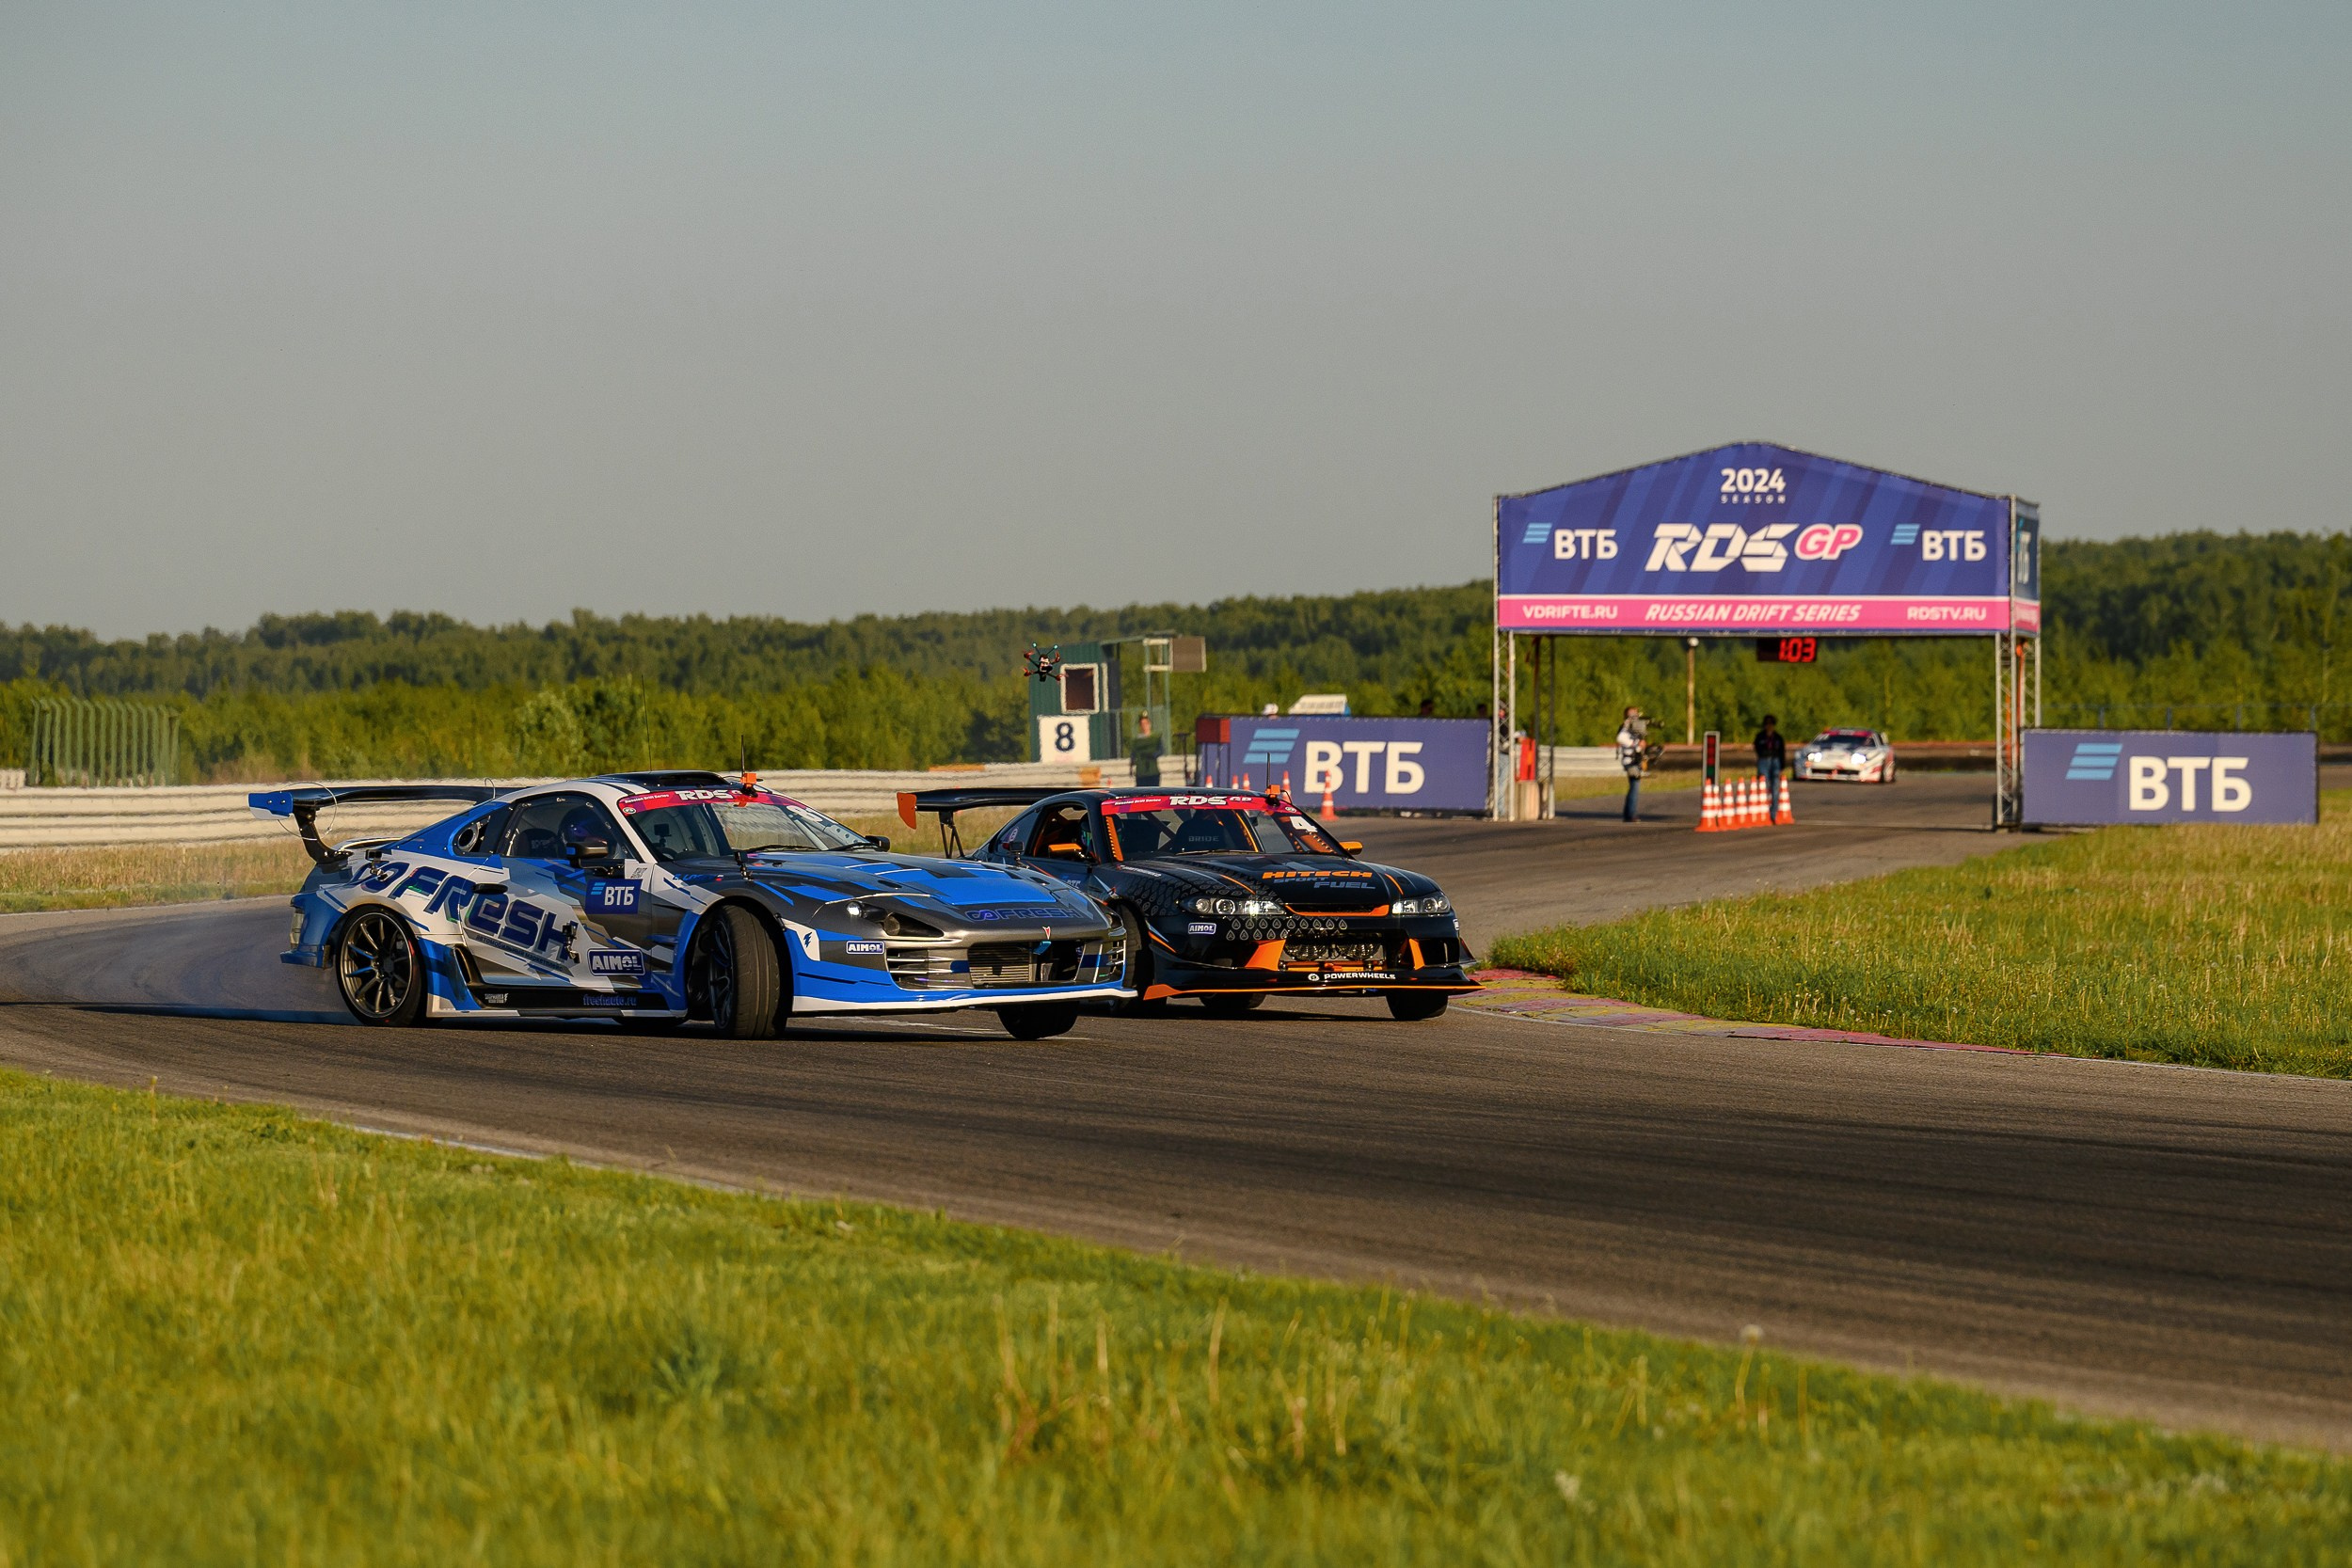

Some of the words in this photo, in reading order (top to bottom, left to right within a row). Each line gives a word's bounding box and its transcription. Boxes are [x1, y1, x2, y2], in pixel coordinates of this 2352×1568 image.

[1720, 467, 1787, 493] 2024
[1720, 494, 1786, 504] SEASON
[1554, 529, 1618, 560] ВТБ
[1645, 523, 1800, 572] RDS
[1794, 523, 1863, 561] GP
[1922, 530, 1987, 562] ВТБ
[1522, 605, 1618, 620] VDRIFTE.RU
[1645, 604, 1733, 621] RUSSIAN
[1732, 604, 1793, 622] DRIFT
[1791, 605, 1863, 623] SERIES
[1906, 607, 1987, 621] RDSTV.RU
[1055, 721, 1075, 752] 8
[1304, 740, 1425, 794] ВТБ
[2128, 755, 2252, 812] ВТБ
[675, 789, 734, 800] RDS
[1169, 796, 1227, 806] RDS
[1290, 816, 1318, 833] 4
[1262, 870, 1373, 879] HITECH
[1313, 881, 1376, 890] FUEL
[604, 886, 634, 906] ВТБ
[1189, 924, 1215, 933] AIMOL
[848, 943, 882, 952] AIMOL
[592, 954, 643, 971] AIMOL
[582, 993, 637, 1006] freshauto.ru
